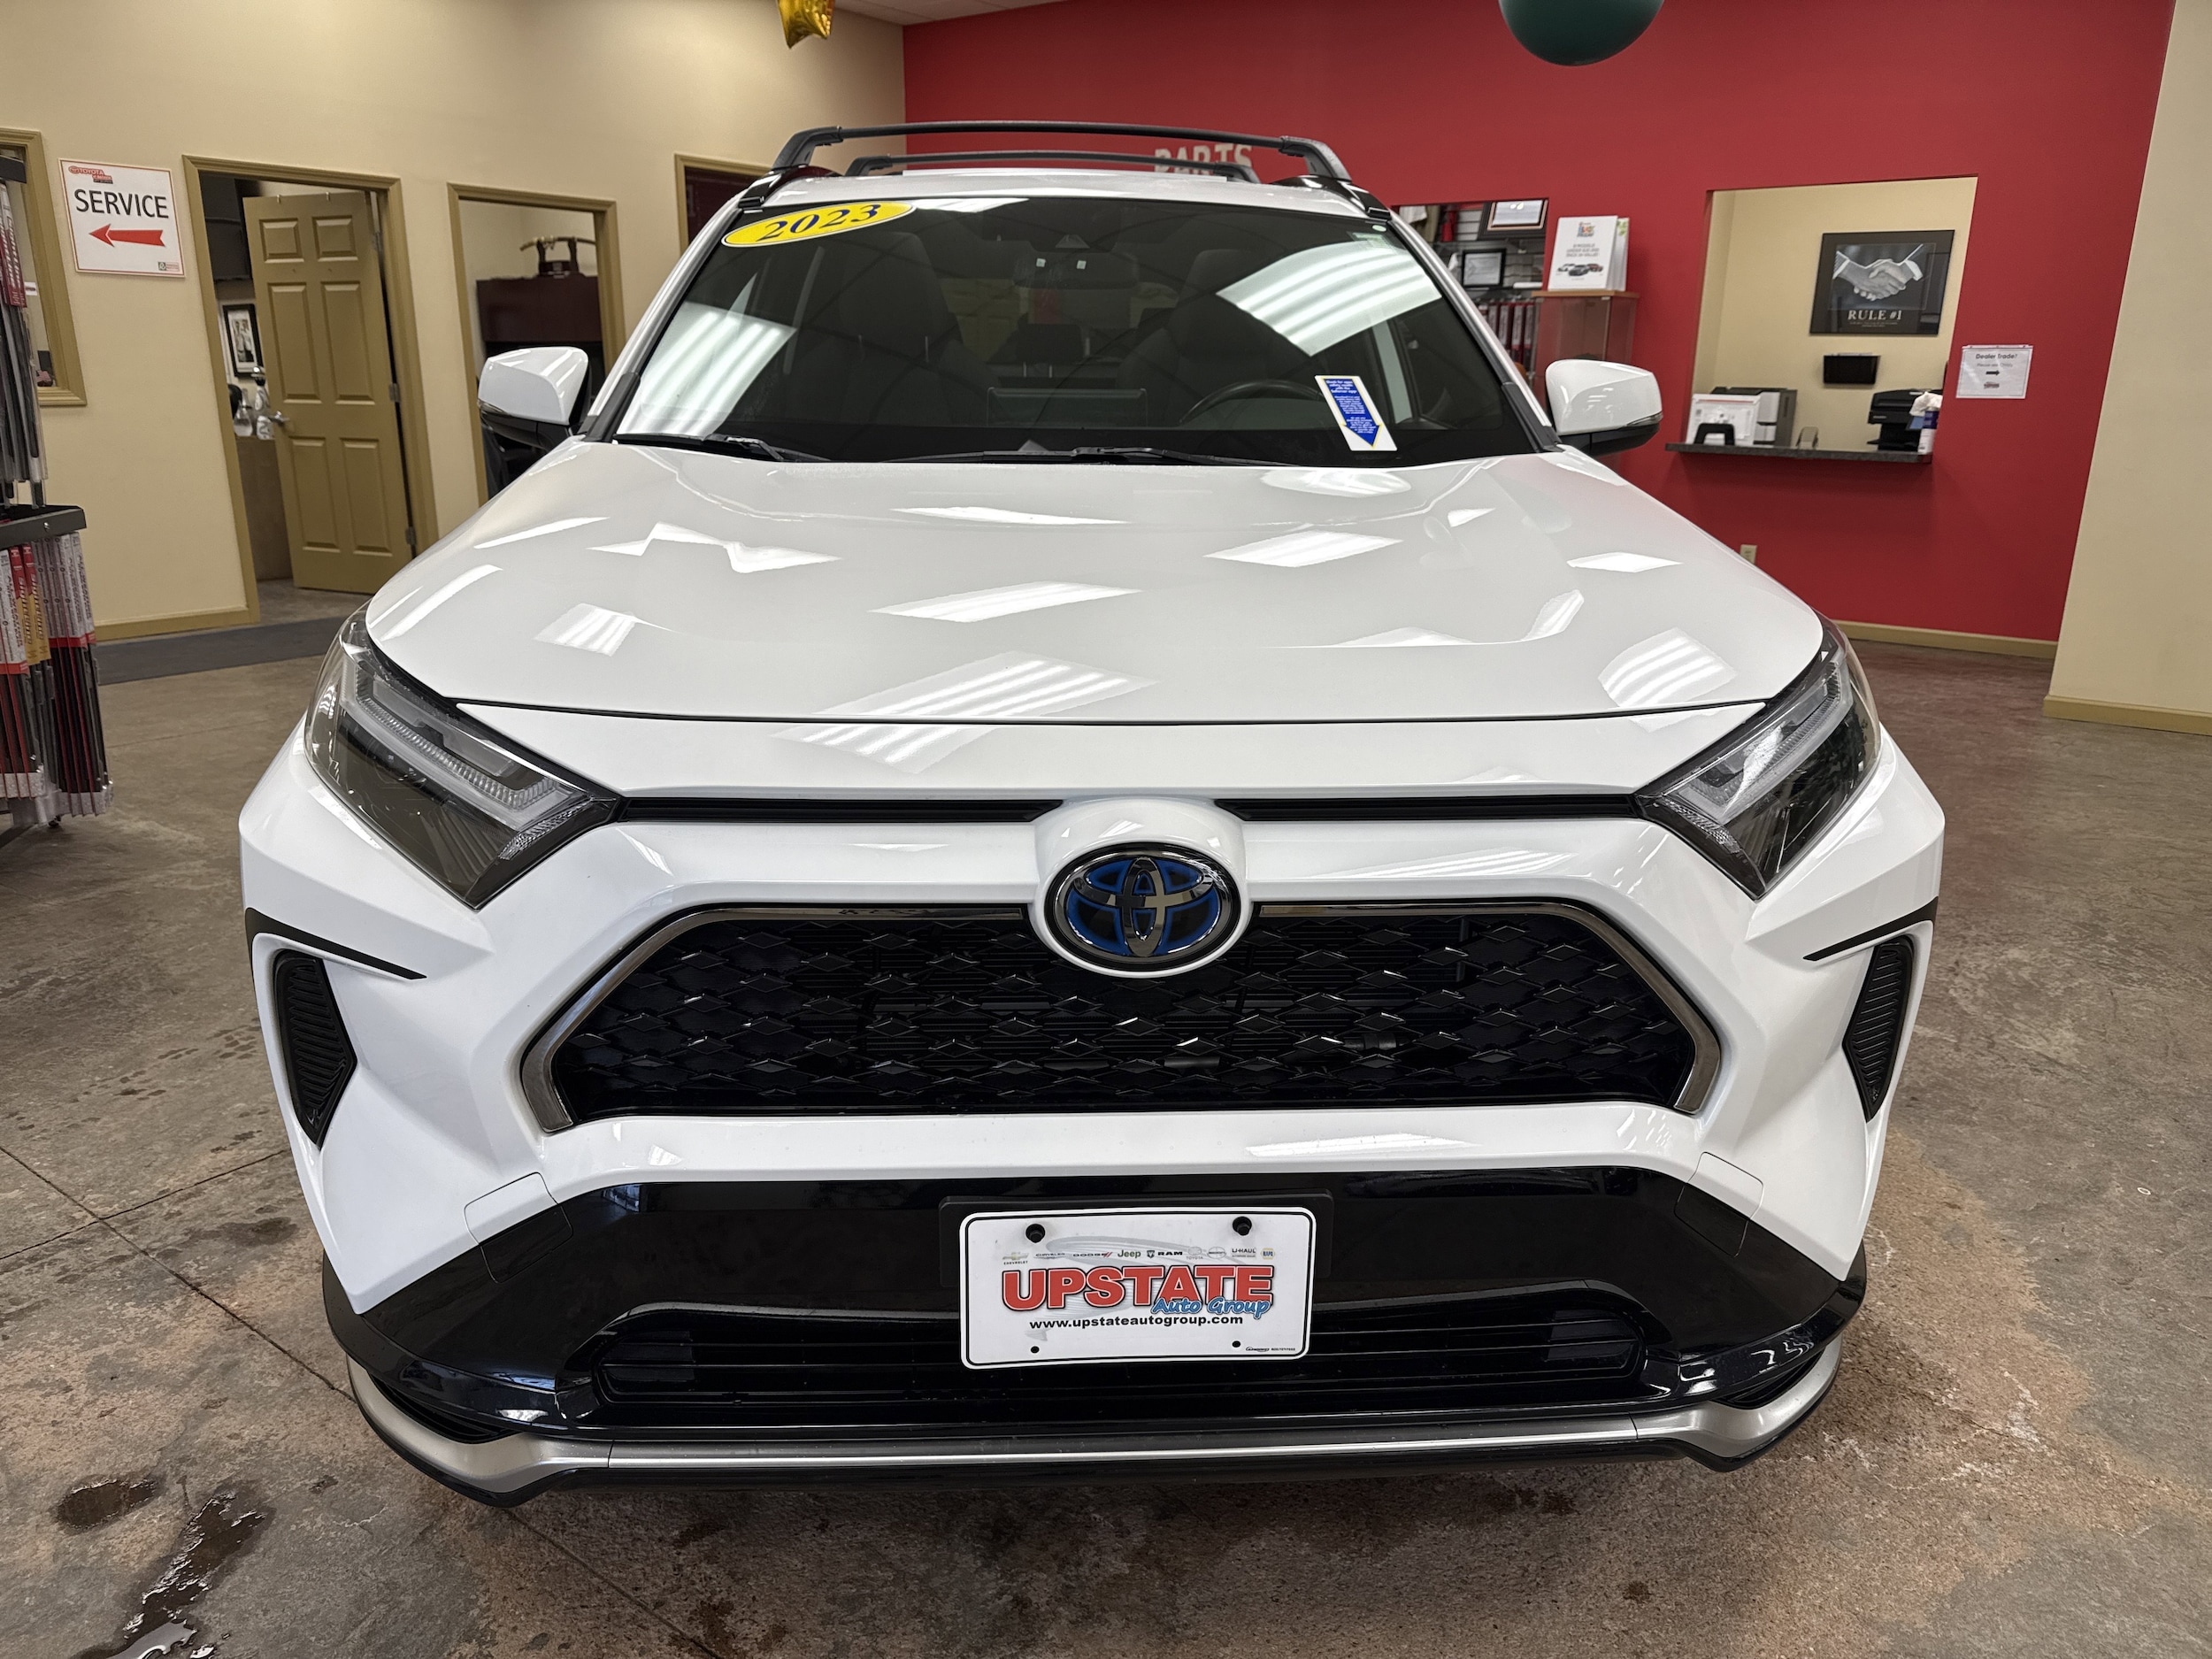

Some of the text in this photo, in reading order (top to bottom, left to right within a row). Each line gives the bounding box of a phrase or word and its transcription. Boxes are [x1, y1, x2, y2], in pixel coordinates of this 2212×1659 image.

[1154, 142, 1253, 175] PARTS
[73, 188, 169, 219] SERVICE
[755, 204, 881, 242] 2023
[1847, 310, 1902, 320] RULE #1
[1118, 1249, 1141, 1259] Jeep
[1002, 1265, 1274, 1311] UPSTATE
[1151, 1296, 1272, 1319] Auto Group
[1029, 1316, 1244, 1330] www.upstateautogroup.com
